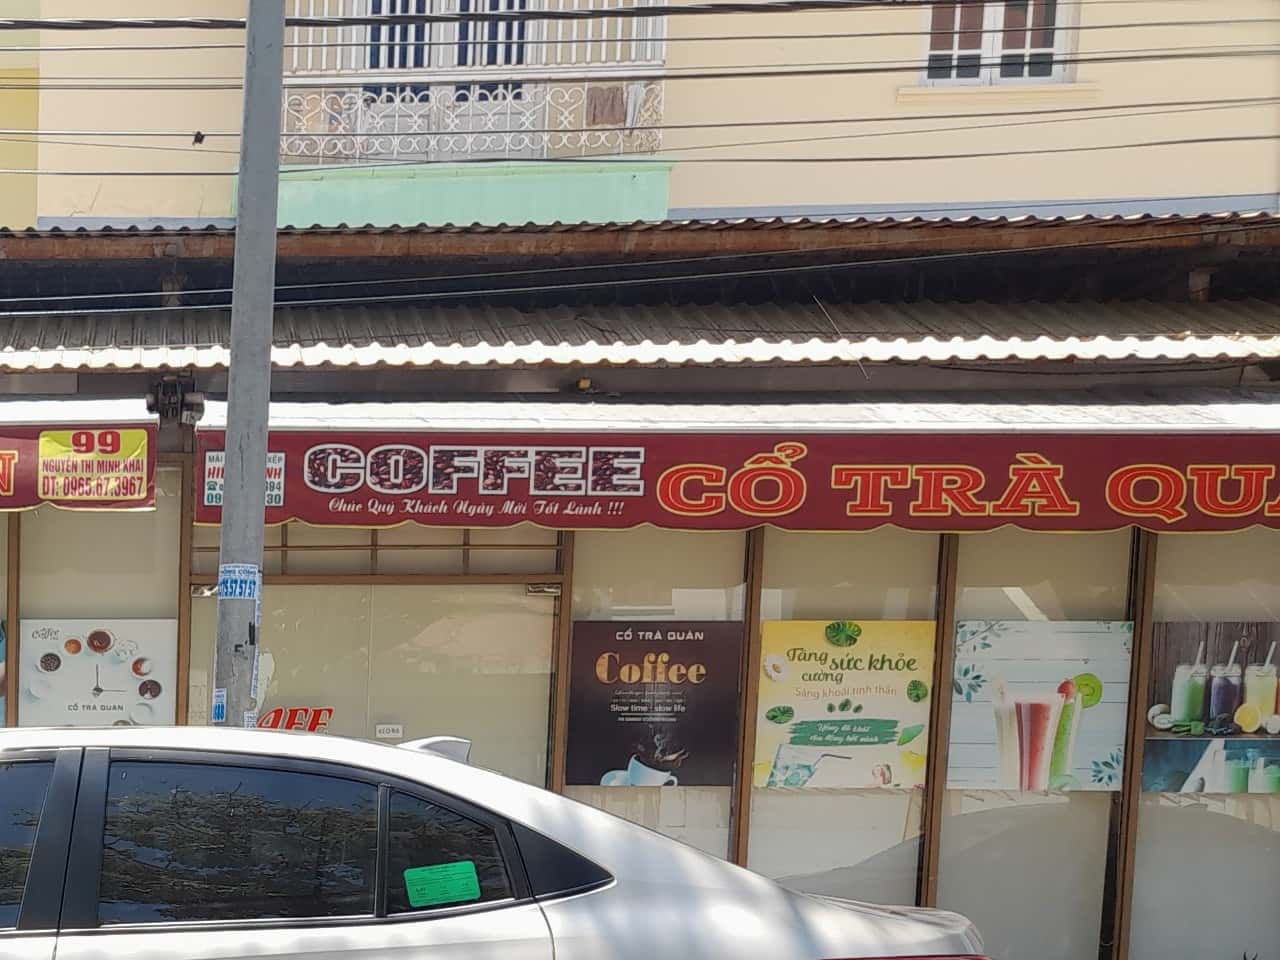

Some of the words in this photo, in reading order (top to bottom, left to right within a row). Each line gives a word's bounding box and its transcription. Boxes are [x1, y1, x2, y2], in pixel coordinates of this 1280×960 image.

[71, 431, 121, 454] 99
[97, 459, 120, 473] MINH
[122, 459, 144, 473] KHAI
[303, 444, 645, 497] COFFEE
[656, 442, 808, 517] CỔ
[831, 453, 1080, 517] TRÀ
[1105, 464, 1280, 524] QU
[328, 498, 363, 513] Chúc
[367, 498, 395, 515] Quý
[399, 498, 448, 514] Khách
[453, 501, 494, 517] Ngày
[497, 500, 528, 515] Mới
[533, 500, 558, 515] Tốt
[563, 501, 603, 515] Lành
[595, 652, 707, 684] Coffee
[786, 648, 828, 665] Tăng
[829, 653, 865, 671] sức
[867, 652, 918, 671] khỏe
[801, 669, 844, 684] cường
